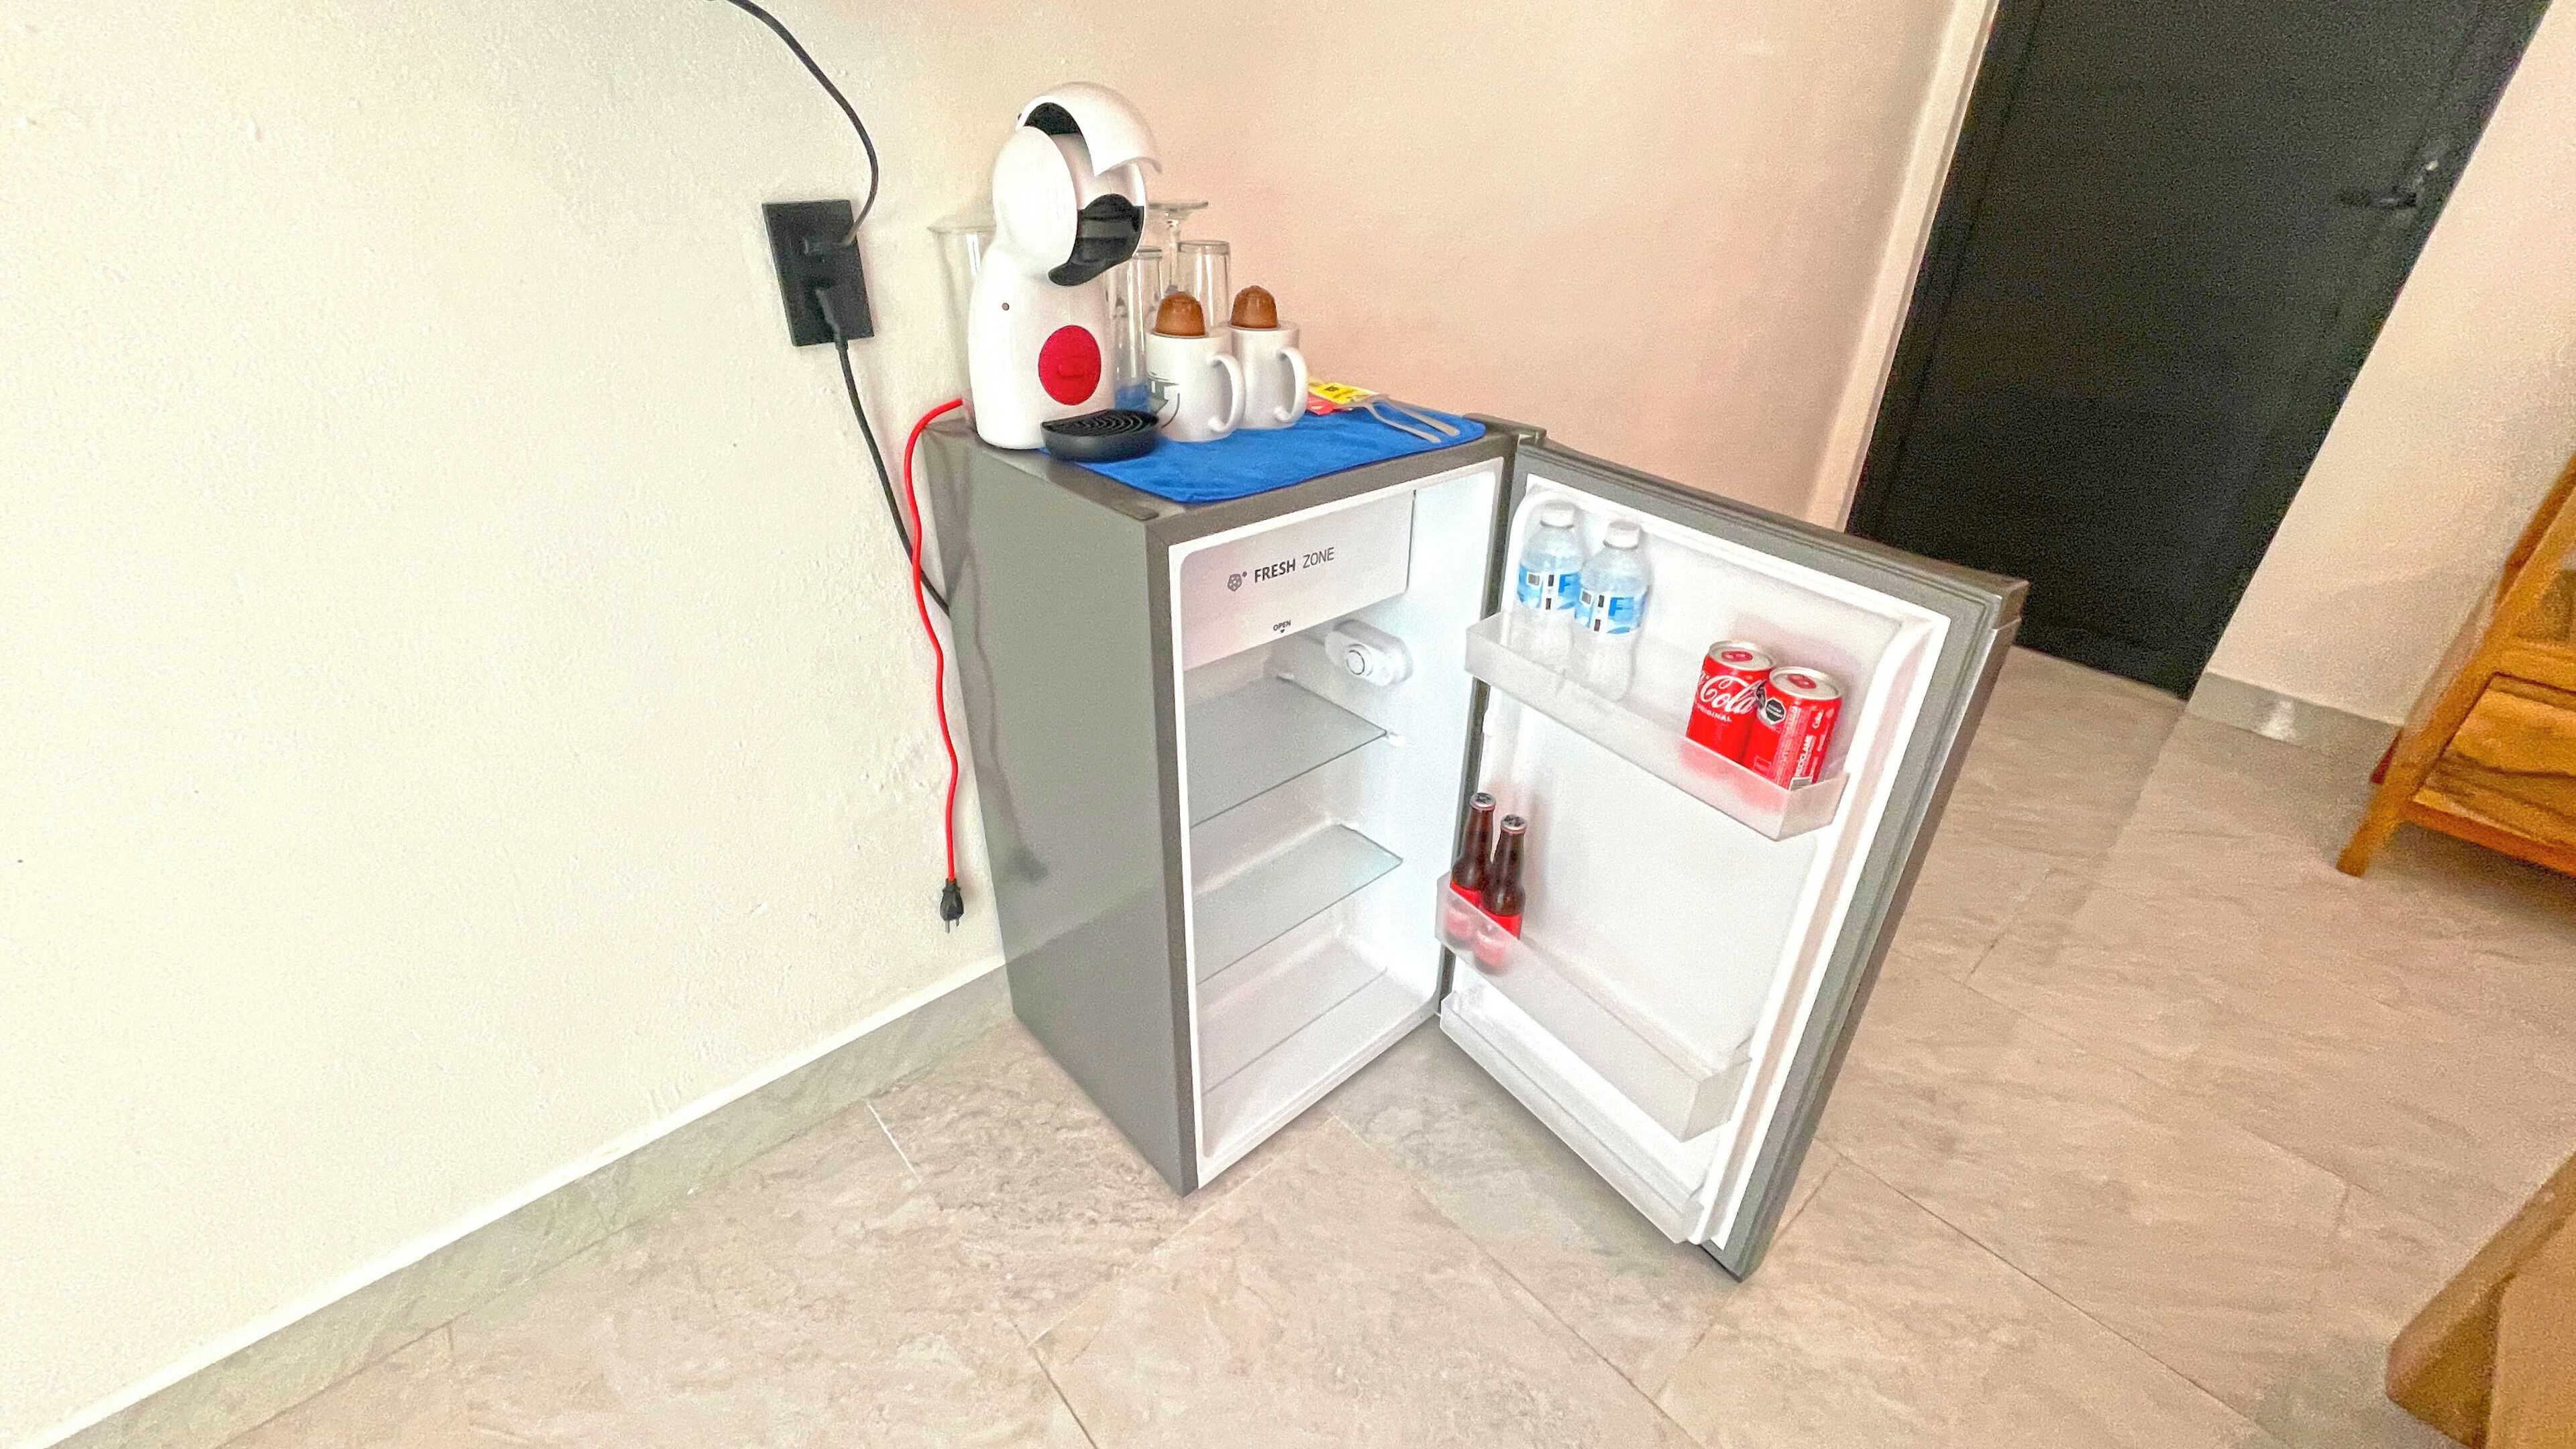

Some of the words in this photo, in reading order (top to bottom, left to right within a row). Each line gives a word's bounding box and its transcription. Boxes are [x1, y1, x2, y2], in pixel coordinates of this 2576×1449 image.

[1254, 558, 1295, 583] FRESH
[1303, 547, 1334, 569] ZONE
[1273, 620, 1291, 631] OPEN
[1700, 675, 1759, 714] Cola
